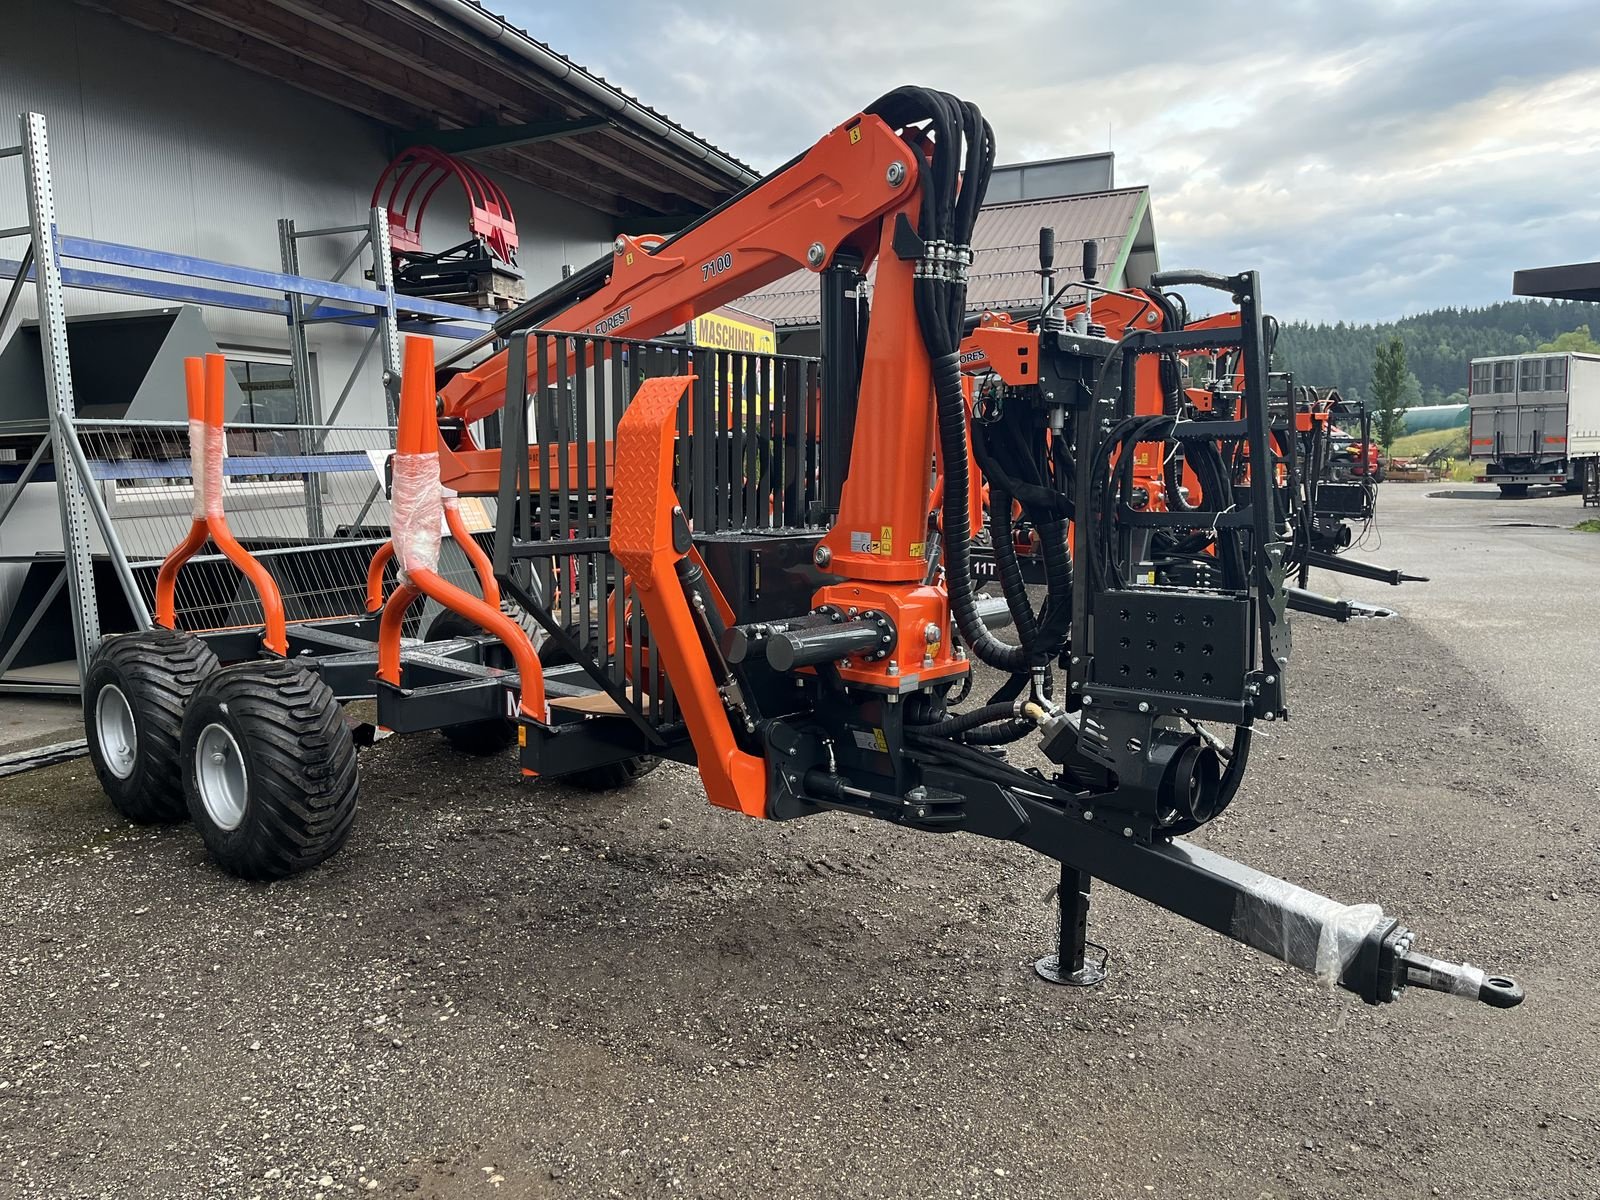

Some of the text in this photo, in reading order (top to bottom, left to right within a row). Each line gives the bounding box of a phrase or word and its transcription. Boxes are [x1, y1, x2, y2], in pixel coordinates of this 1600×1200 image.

[700, 251, 733, 283] 7100
[594, 305, 632, 335] FOREST
[699, 317, 755, 352] MASCHINEN
[959, 349, 986, 364] ORES
[973, 561, 997, 576] 11T
